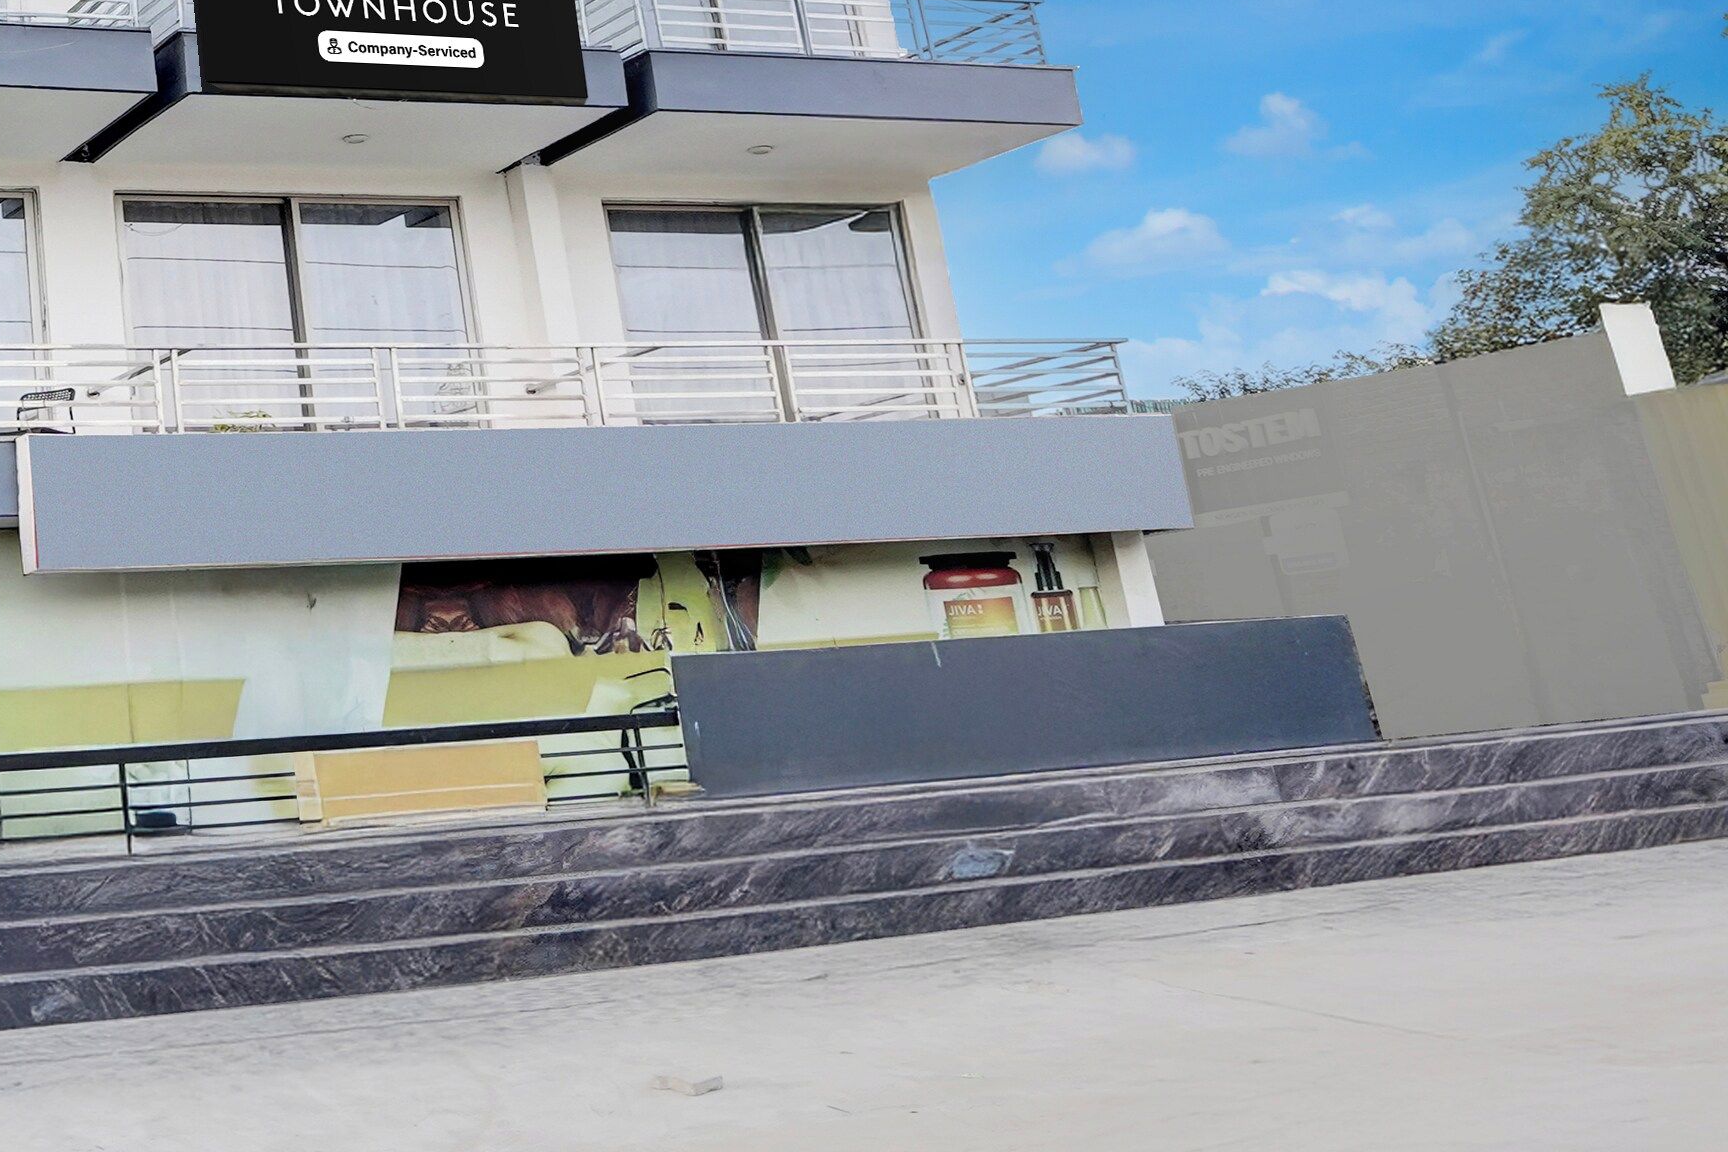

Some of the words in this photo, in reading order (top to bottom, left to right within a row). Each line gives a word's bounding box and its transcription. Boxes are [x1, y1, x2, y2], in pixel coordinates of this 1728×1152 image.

[347, 40, 477, 59] Company-Serviced
[1179, 408, 1322, 459] TOSTEM
[1196, 465, 1215, 478] PRE
[1215, 456, 1273, 475] ENGINEERED
[1274, 448, 1322, 464] WINDOWS
[949, 604, 976, 616] JIVA
